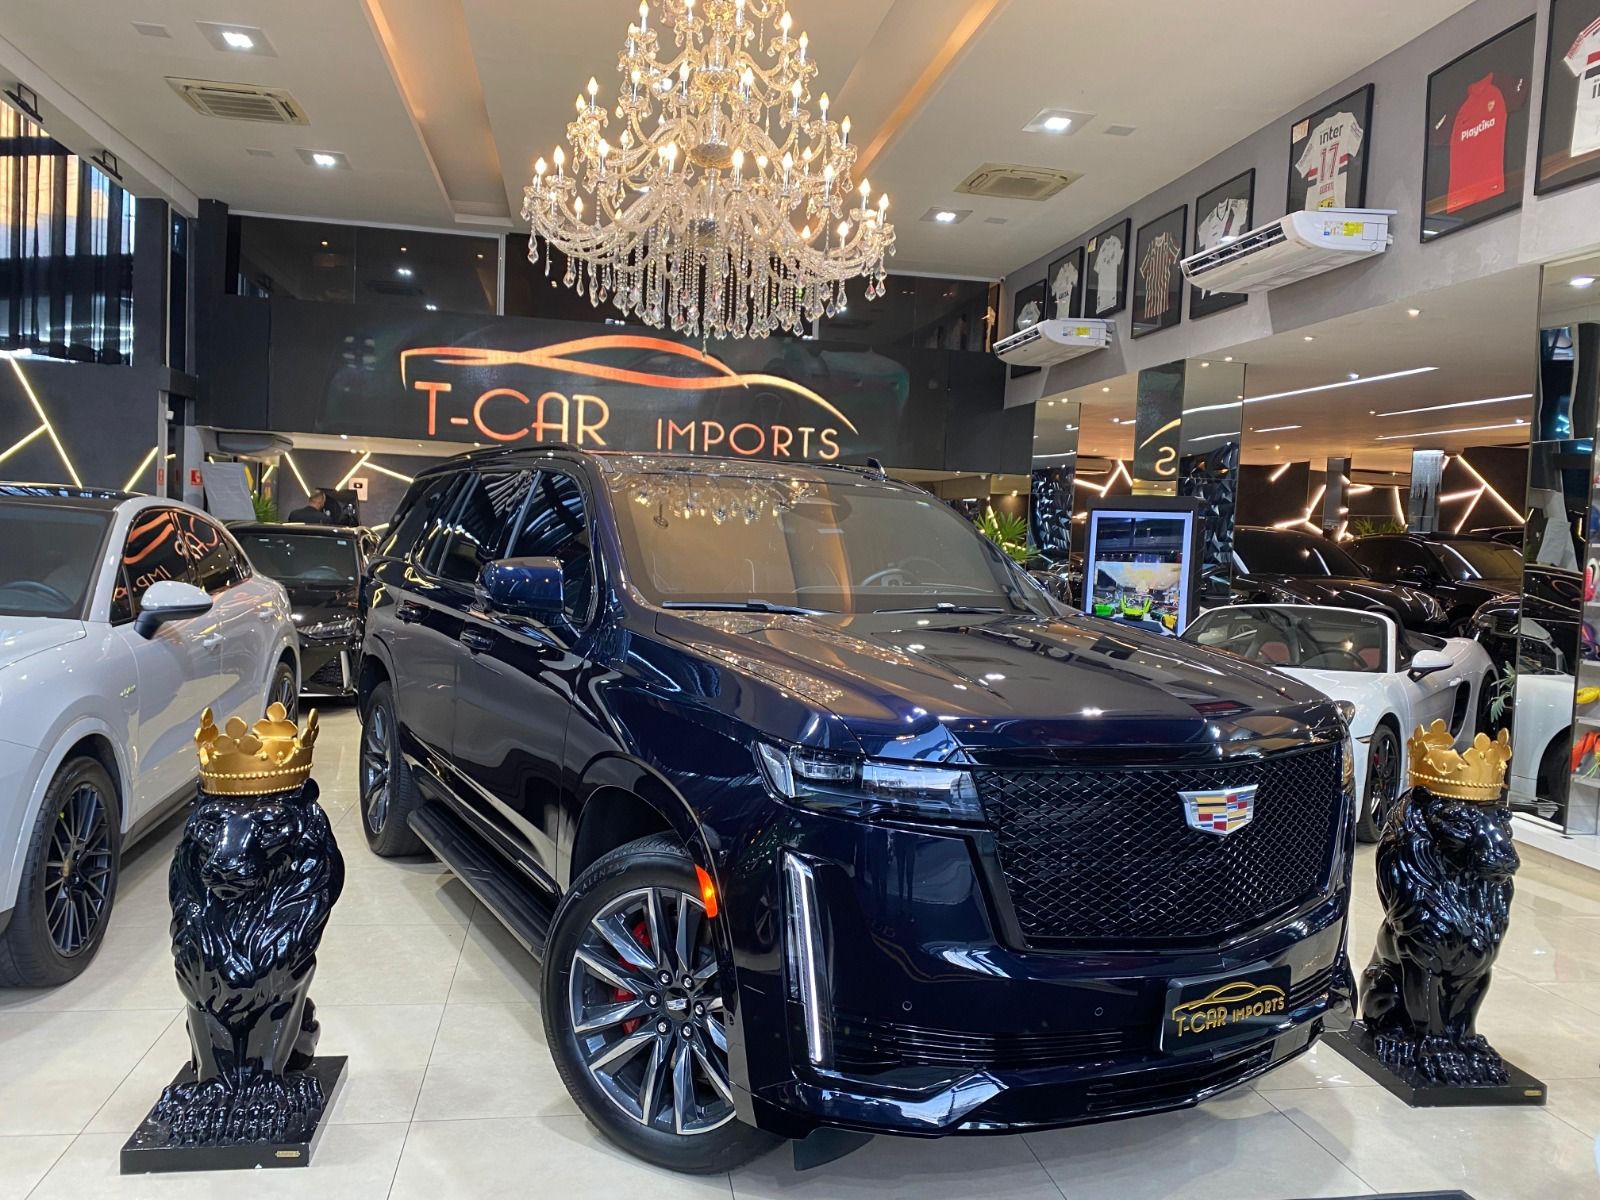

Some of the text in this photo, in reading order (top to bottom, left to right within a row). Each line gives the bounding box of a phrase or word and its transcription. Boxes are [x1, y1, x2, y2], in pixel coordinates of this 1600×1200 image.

[1319, 123, 1344, 146] inter
[1461, 117, 1496, 142] Playtika
[1319, 142, 1340, 182] 17
[414, 381, 840, 459] T-CAR IMPORTS
[1175, 997, 1286, 1037] T-CAR IMPORTS
